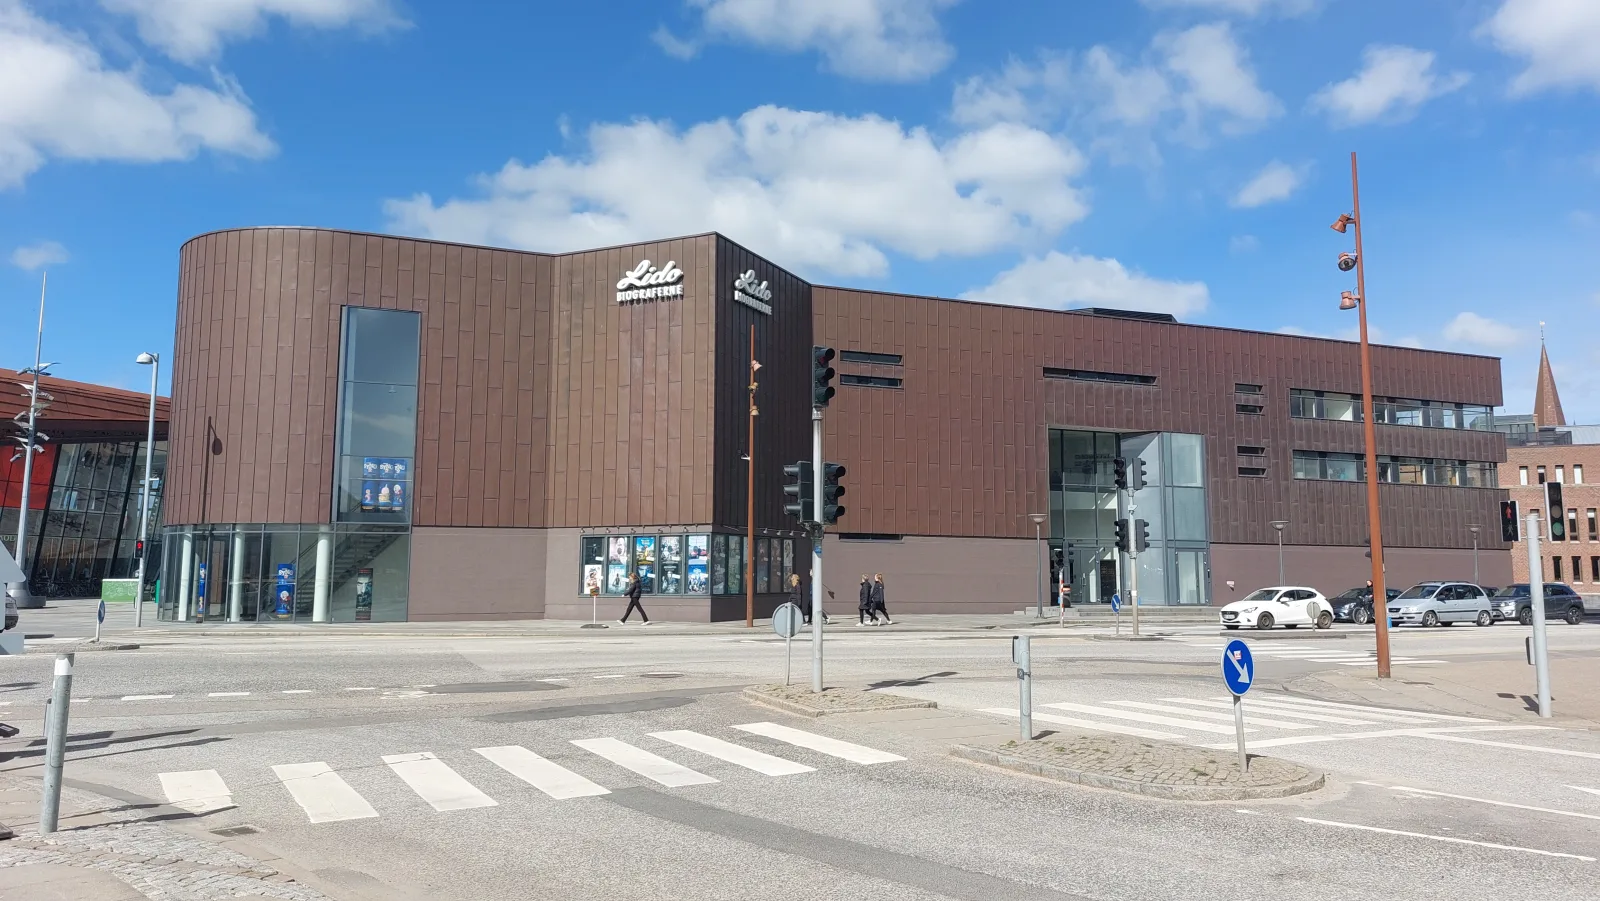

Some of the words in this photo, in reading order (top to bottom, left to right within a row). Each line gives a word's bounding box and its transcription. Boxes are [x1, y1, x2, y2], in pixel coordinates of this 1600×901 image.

[616, 259, 684, 290] Lido
[734, 269, 772, 301] Lido
[616, 284, 684, 302] BIOGRAFERNE
